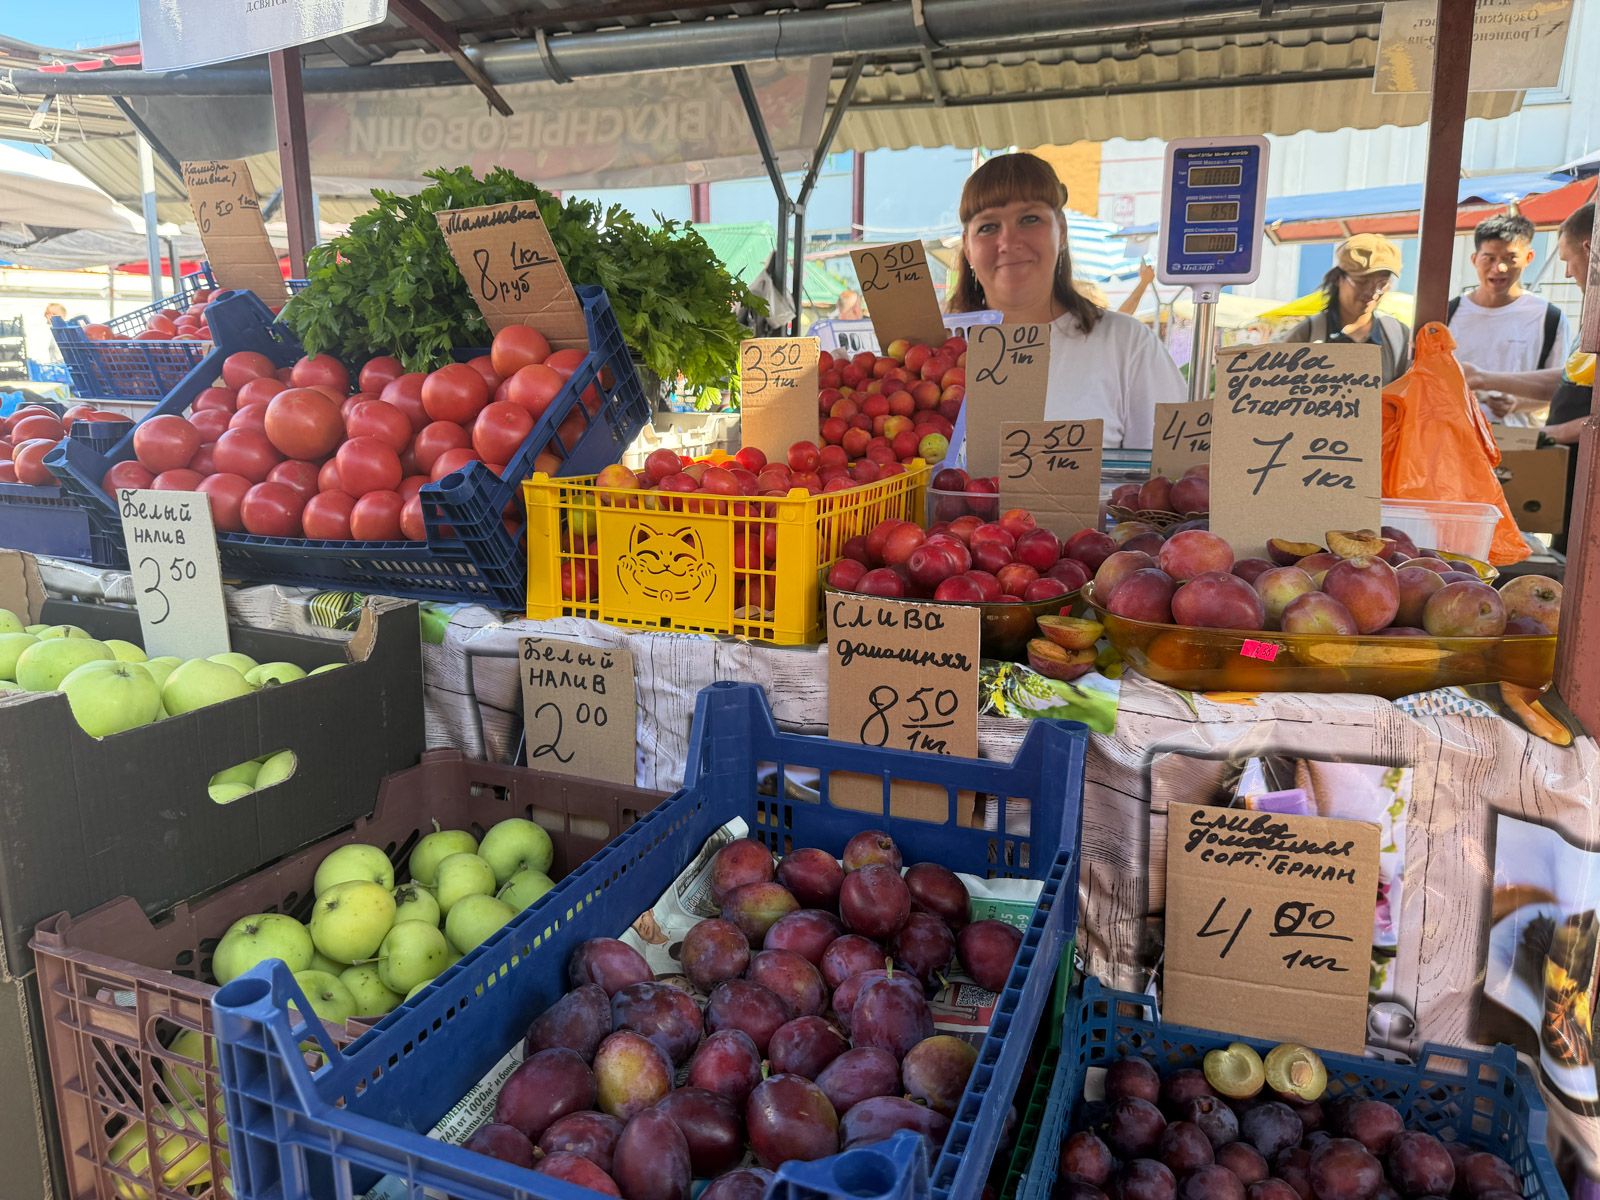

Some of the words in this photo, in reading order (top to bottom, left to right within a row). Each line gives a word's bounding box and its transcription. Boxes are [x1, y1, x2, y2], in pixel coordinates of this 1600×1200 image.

[199, 201, 211, 233] 6
[215, 200, 233, 214] 50
[446, 205, 540, 235] Малиновка
[473, 249, 498, 301] 8
[500, 272, 530, 302] руб
[860, 252, 890, 291] 2
[883, 244, 915, 268] 50
[745, 345, 768, 394] 3
[770, 343, 801, 366] 50
[976, 326, 1008, 385] 2
[1013, 325, 1038, 344] 00
[1006, 429, 1033, 479] 3
[1043, 424, 1084, 449] 50
[1163, 410, 1187, 450] 4
[1197, 411, 1212, 427] 0
[1247, 432, 1294, 495] 7
[1309, 438, 1348, 454] 00
[122, 490, 192, 521] Белый
[140, 557, 170, 624] 3
[170, 557, 196, 581] 50
[524, 638, 614, 669] Белый
[533, 702, 575, 763] 2
[576, 703, 608, 727] 00
[860, 685, 899, 746] 8
[907, 687, 958, 722] 50
[1197, 897, 1252, 958] 4
